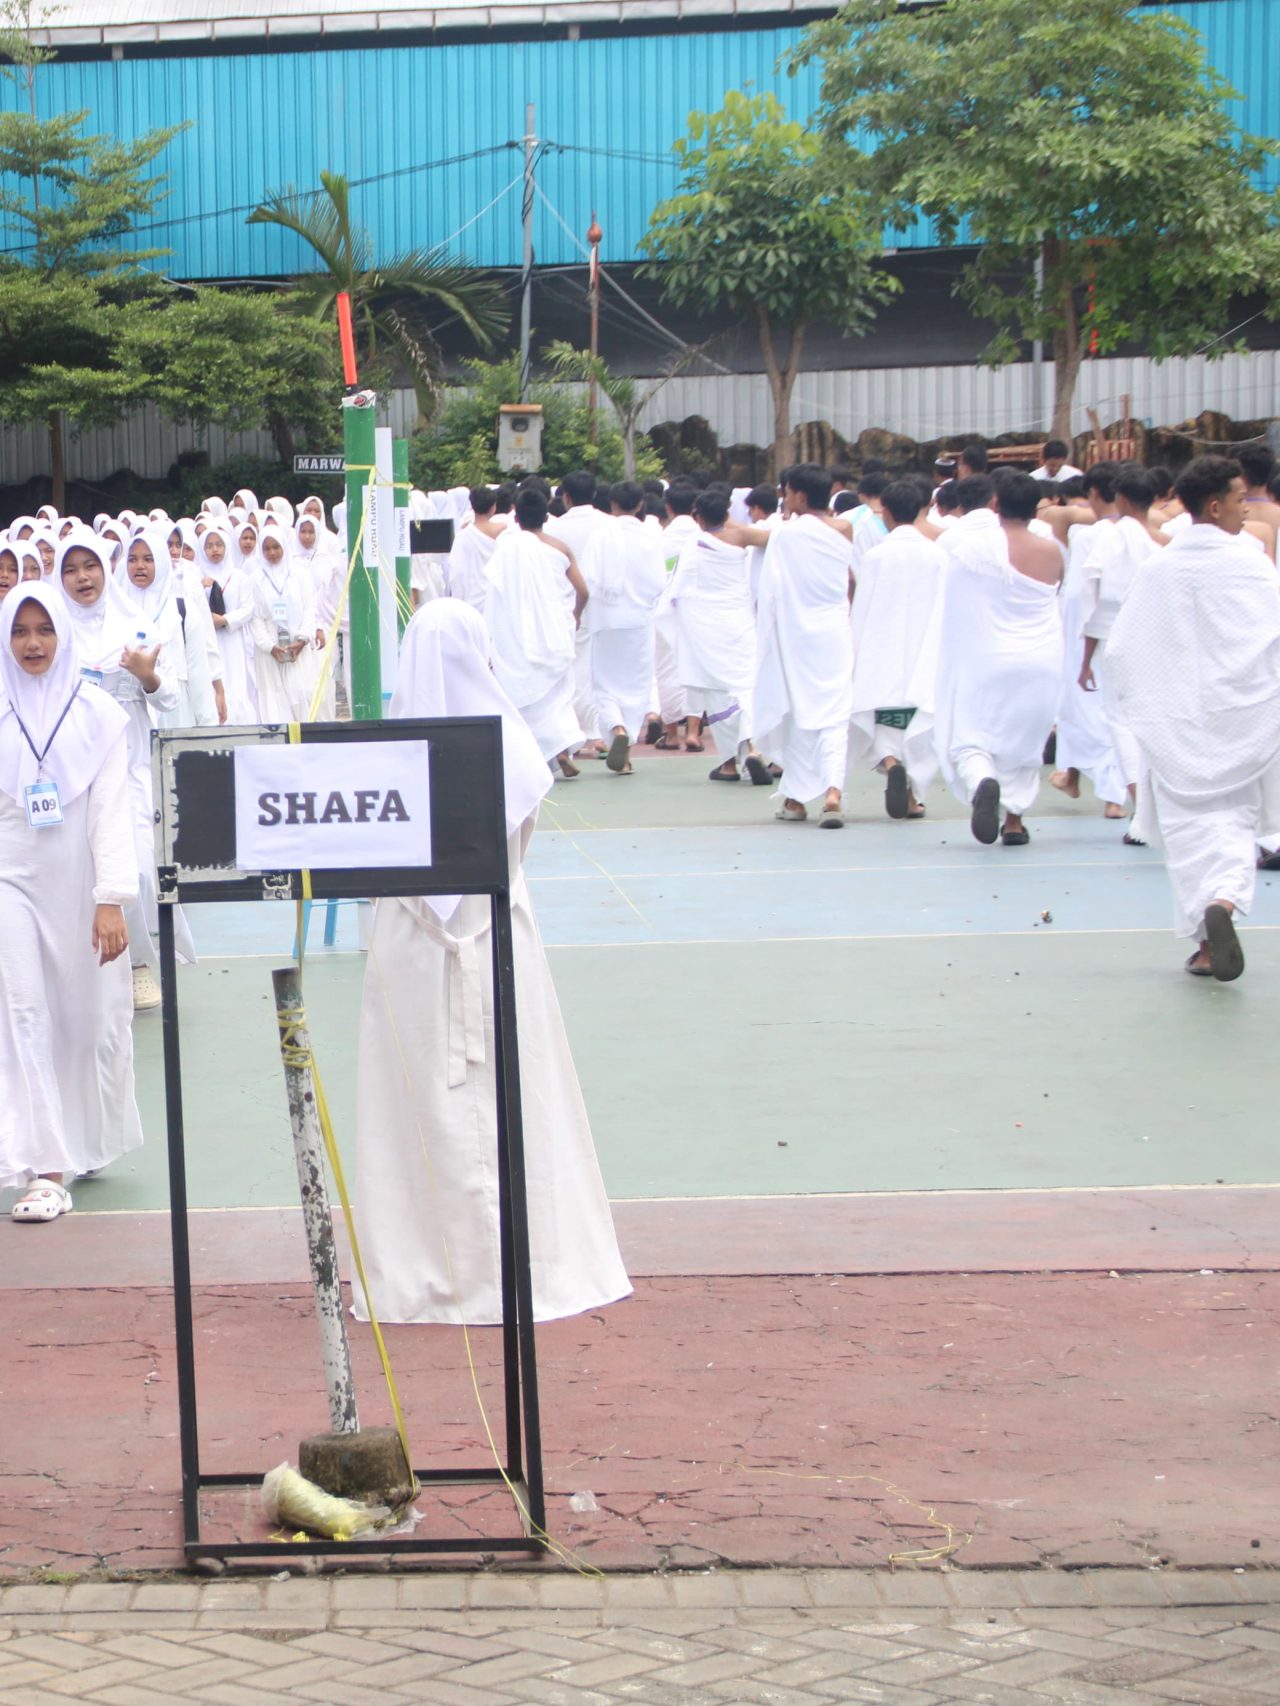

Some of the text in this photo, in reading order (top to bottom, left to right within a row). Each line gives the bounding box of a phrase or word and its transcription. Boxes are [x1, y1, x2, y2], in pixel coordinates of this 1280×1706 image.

[32, 799, 57, 813] A 09
[258, 790, 411, 826] SHAFA
